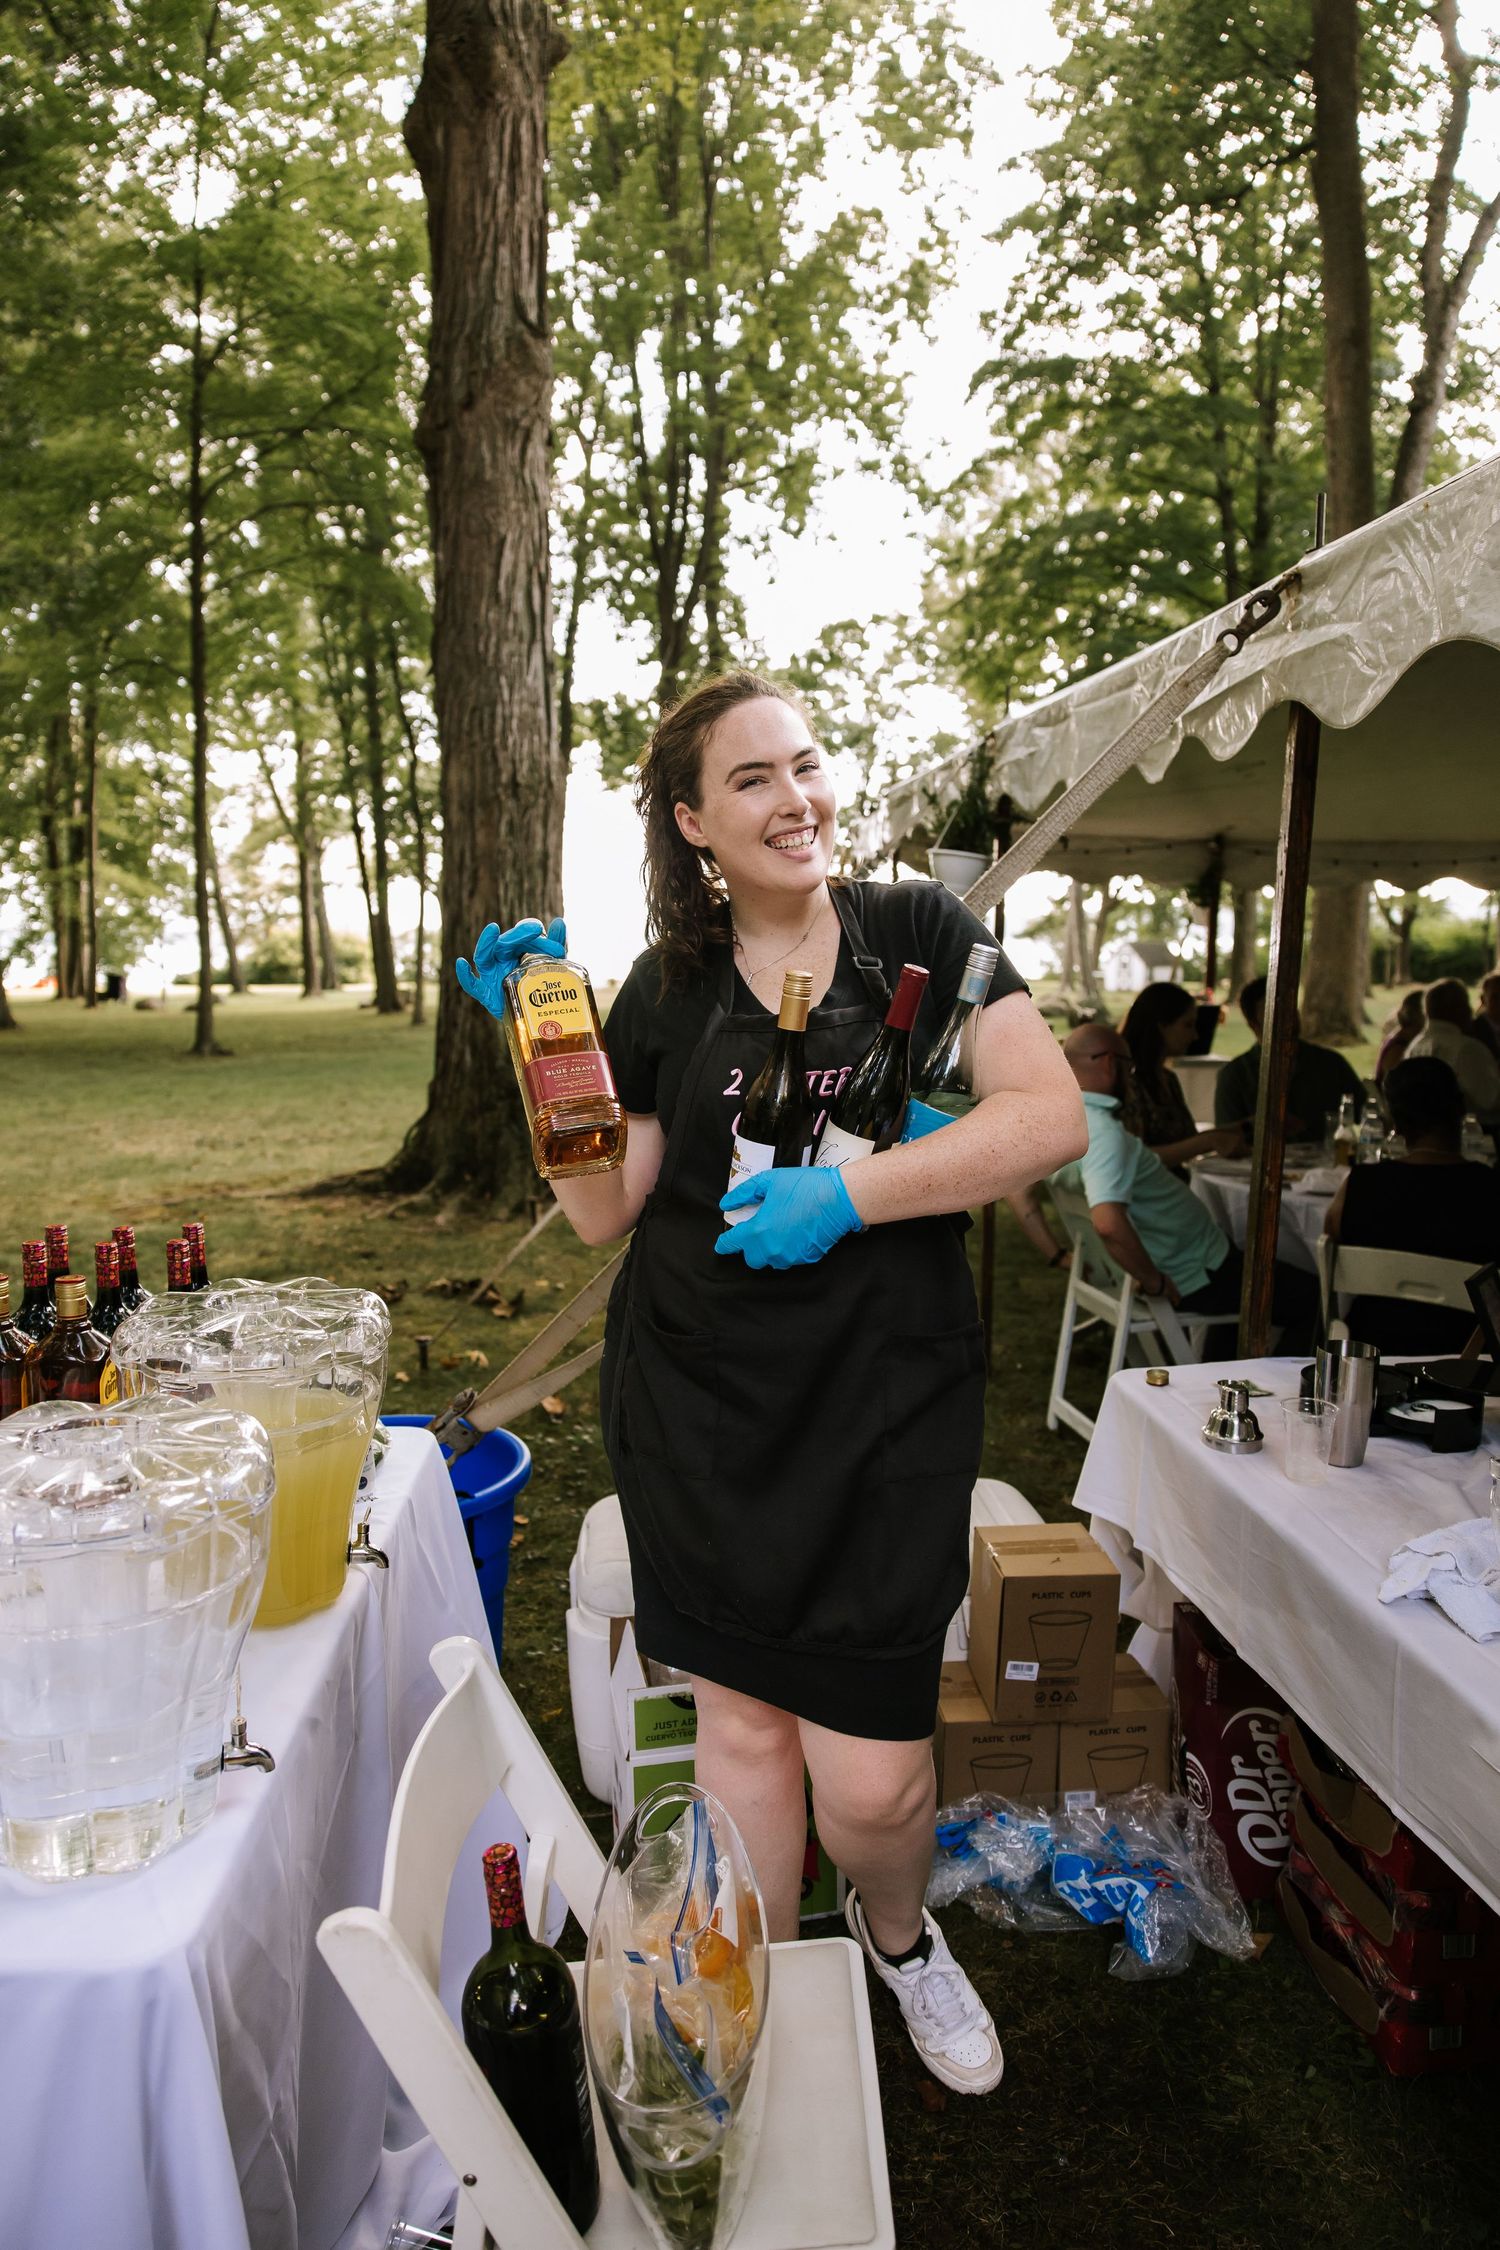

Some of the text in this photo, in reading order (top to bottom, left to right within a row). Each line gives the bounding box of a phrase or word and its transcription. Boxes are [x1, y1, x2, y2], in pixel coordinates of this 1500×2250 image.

[542, 980, 562, 992] Jose
[528, 988, 578, 1008] Cuervo
[537, 1007, 580, 1018] ESPECIAL
[545, 1065, 598, 1076] BLUE AGAVE
[722, 1068, 744, 1096] 2
[1031, 1590, 1092, 1600] PLASTIC CUPS
[653, 1720, 679, 1731] JUST
[681, 1717, 698, 1727] AD
[645, 1732, 677, 1742] CUERVO
[1089, 1725, 1148, 1737] PLASTIC CUPS
[972, 1734, 1032, 1744] PLASTIC CUPS
[1227, 1754, 1274, 1812] Dr
